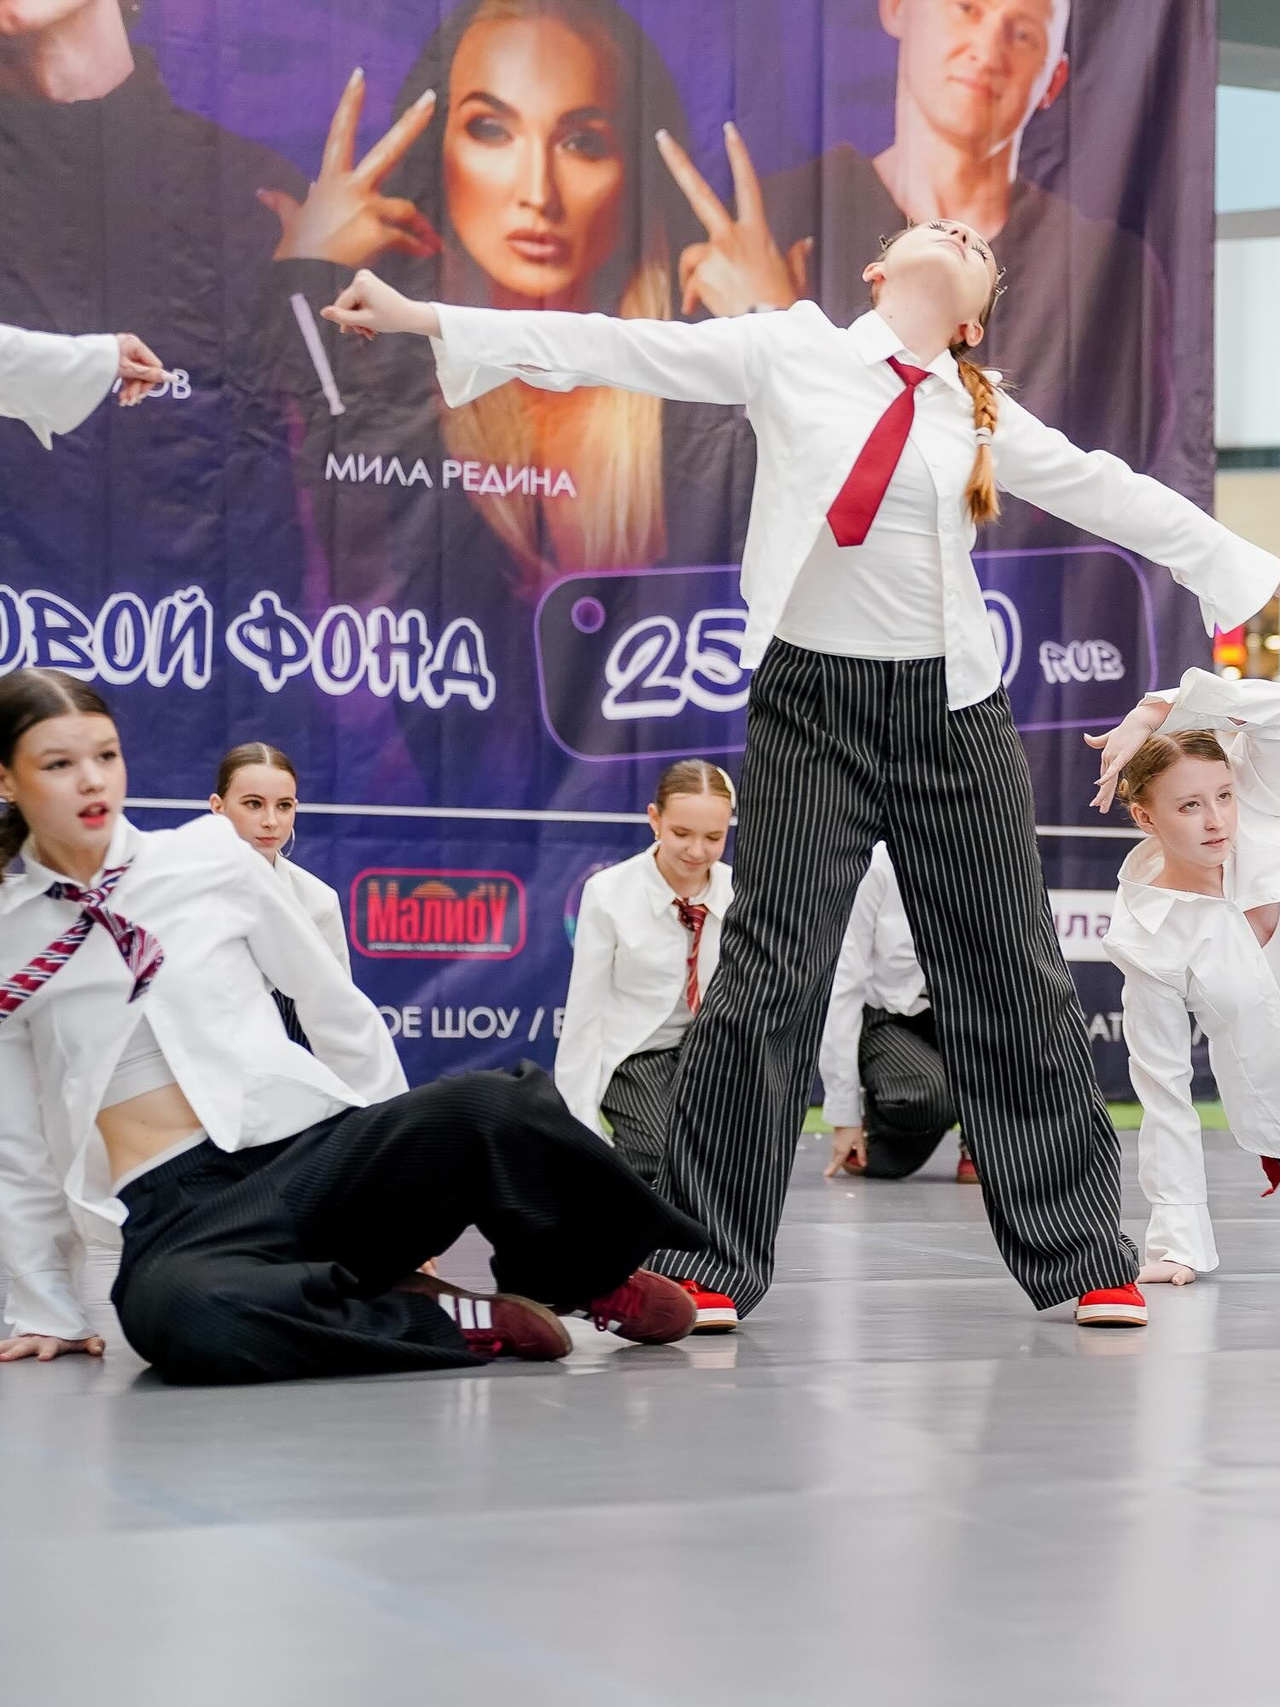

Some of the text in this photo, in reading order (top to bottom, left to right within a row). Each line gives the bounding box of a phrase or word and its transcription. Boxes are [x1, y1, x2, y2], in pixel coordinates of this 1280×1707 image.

[325, 453, 578, 499] МИЛА РЕДИНА
[1039, 640, 1125, 684] RUB
[431, 1006, 521, 1039] ШОУ
